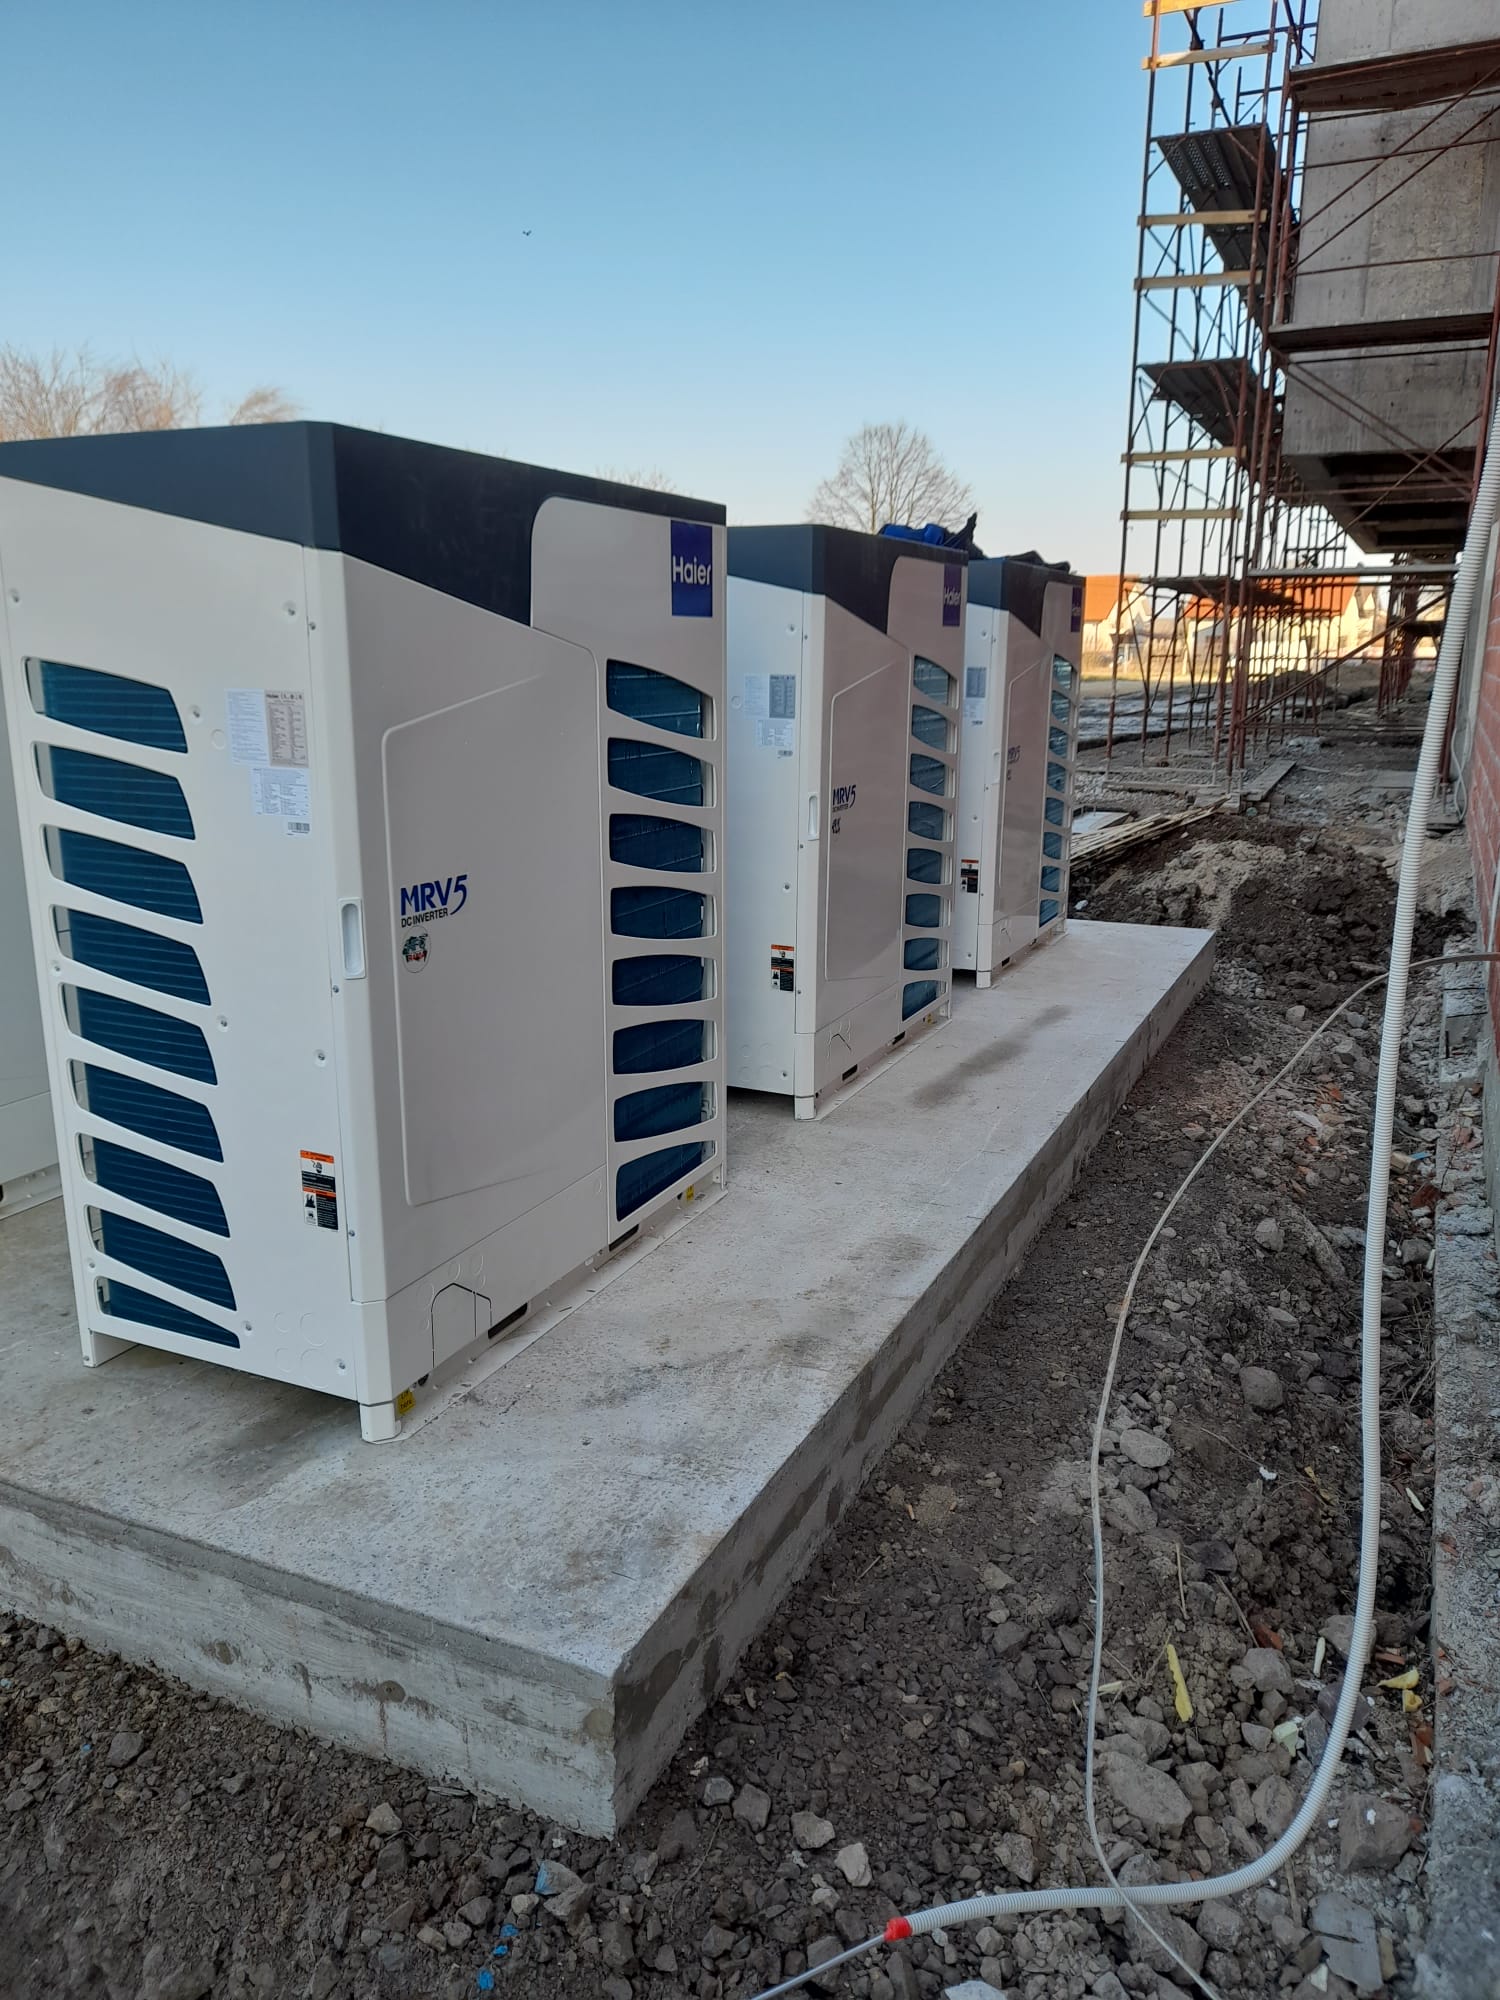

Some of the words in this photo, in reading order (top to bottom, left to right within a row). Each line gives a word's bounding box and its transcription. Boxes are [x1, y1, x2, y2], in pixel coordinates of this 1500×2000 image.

[672, 555, 712, 585] Haier
[832, 784, 857, 809] MRV5
[400, 874, 468, 916] MRV5
